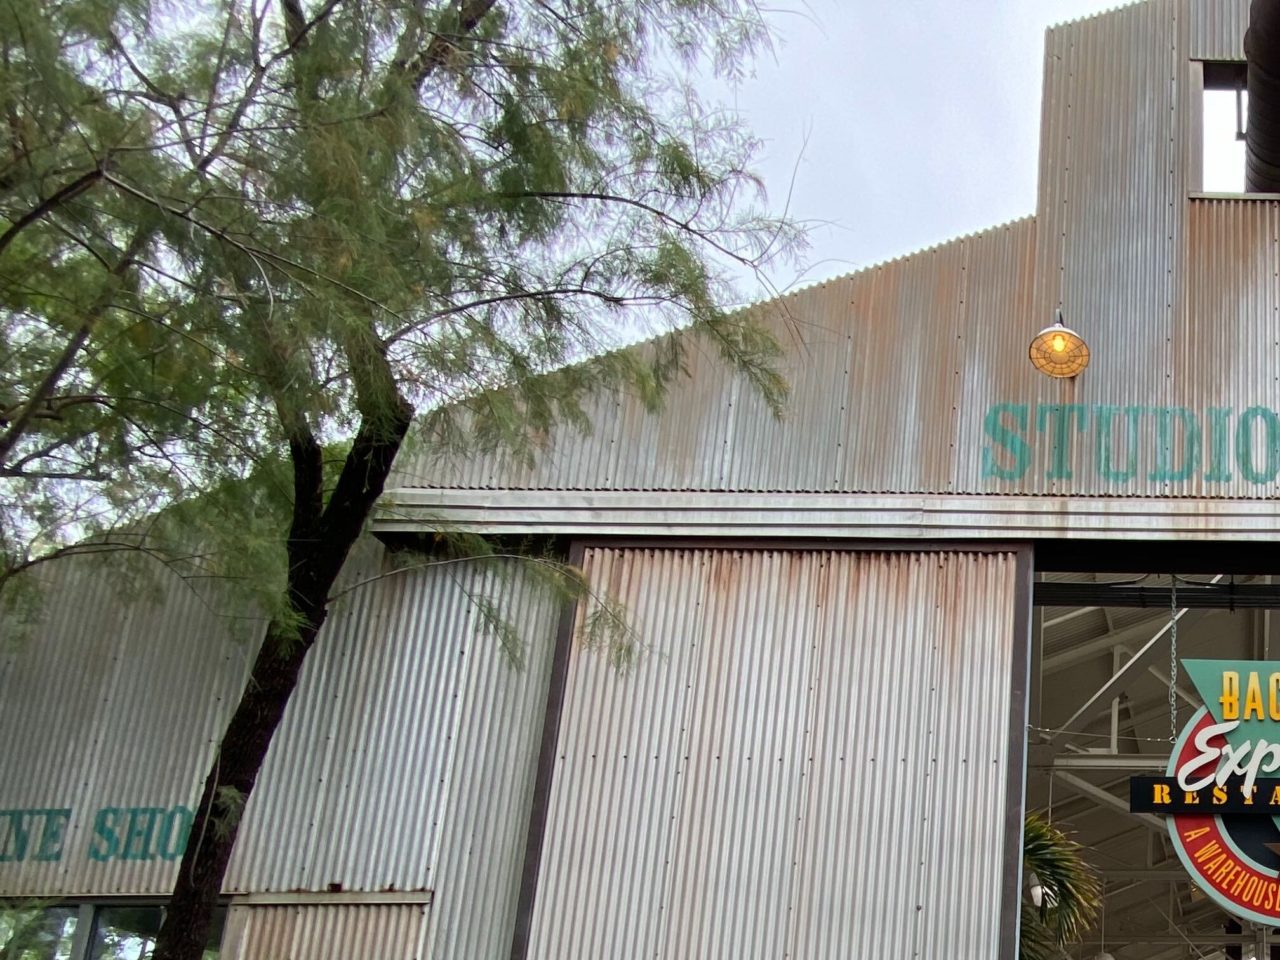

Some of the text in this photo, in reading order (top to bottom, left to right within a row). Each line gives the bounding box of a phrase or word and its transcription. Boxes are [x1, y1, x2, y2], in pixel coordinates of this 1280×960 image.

[0, 805, 194, 862] NE SHO
[1184, 826, 1210, 842] A
